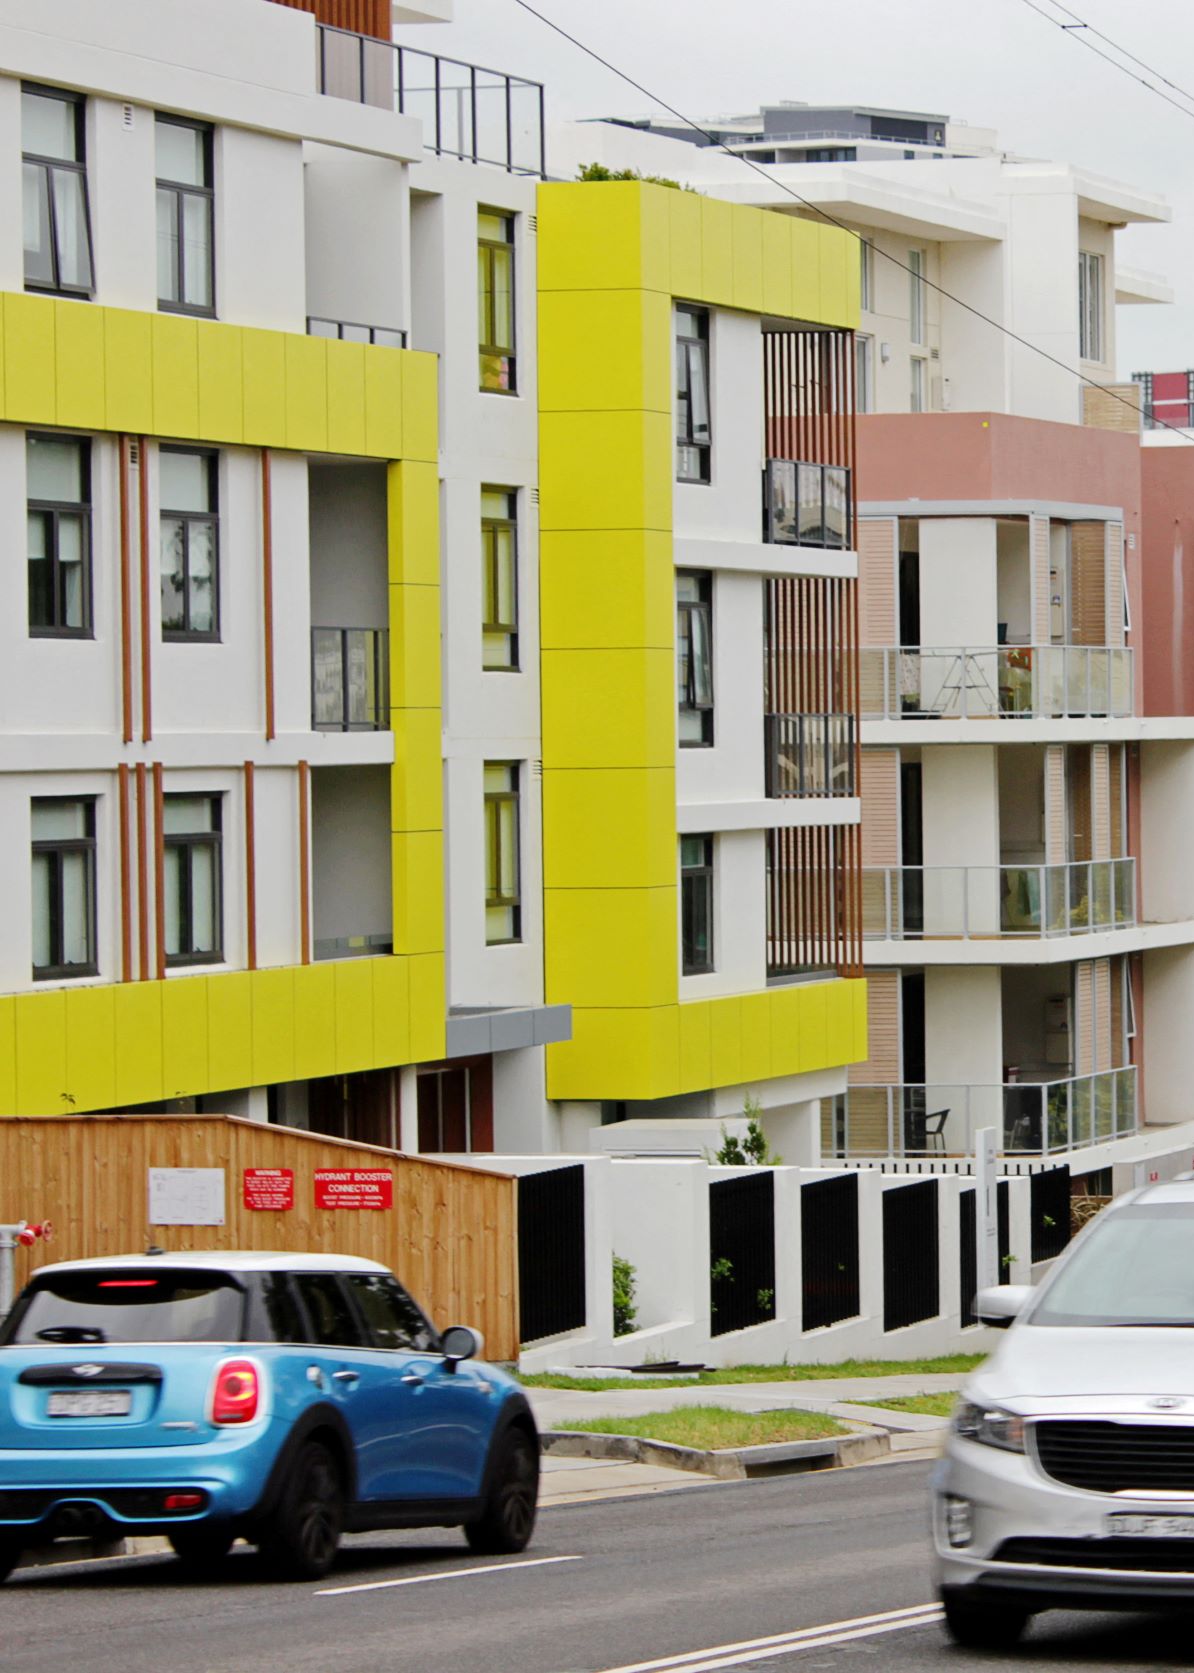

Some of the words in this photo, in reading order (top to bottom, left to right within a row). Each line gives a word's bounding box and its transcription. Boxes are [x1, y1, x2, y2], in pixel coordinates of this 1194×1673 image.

[313, 1172, 351, 1182] HYDRANT
[354, 1172, 393, 1182] BOOSTER
[328, 1184, 380, 1193] CONNECTION
